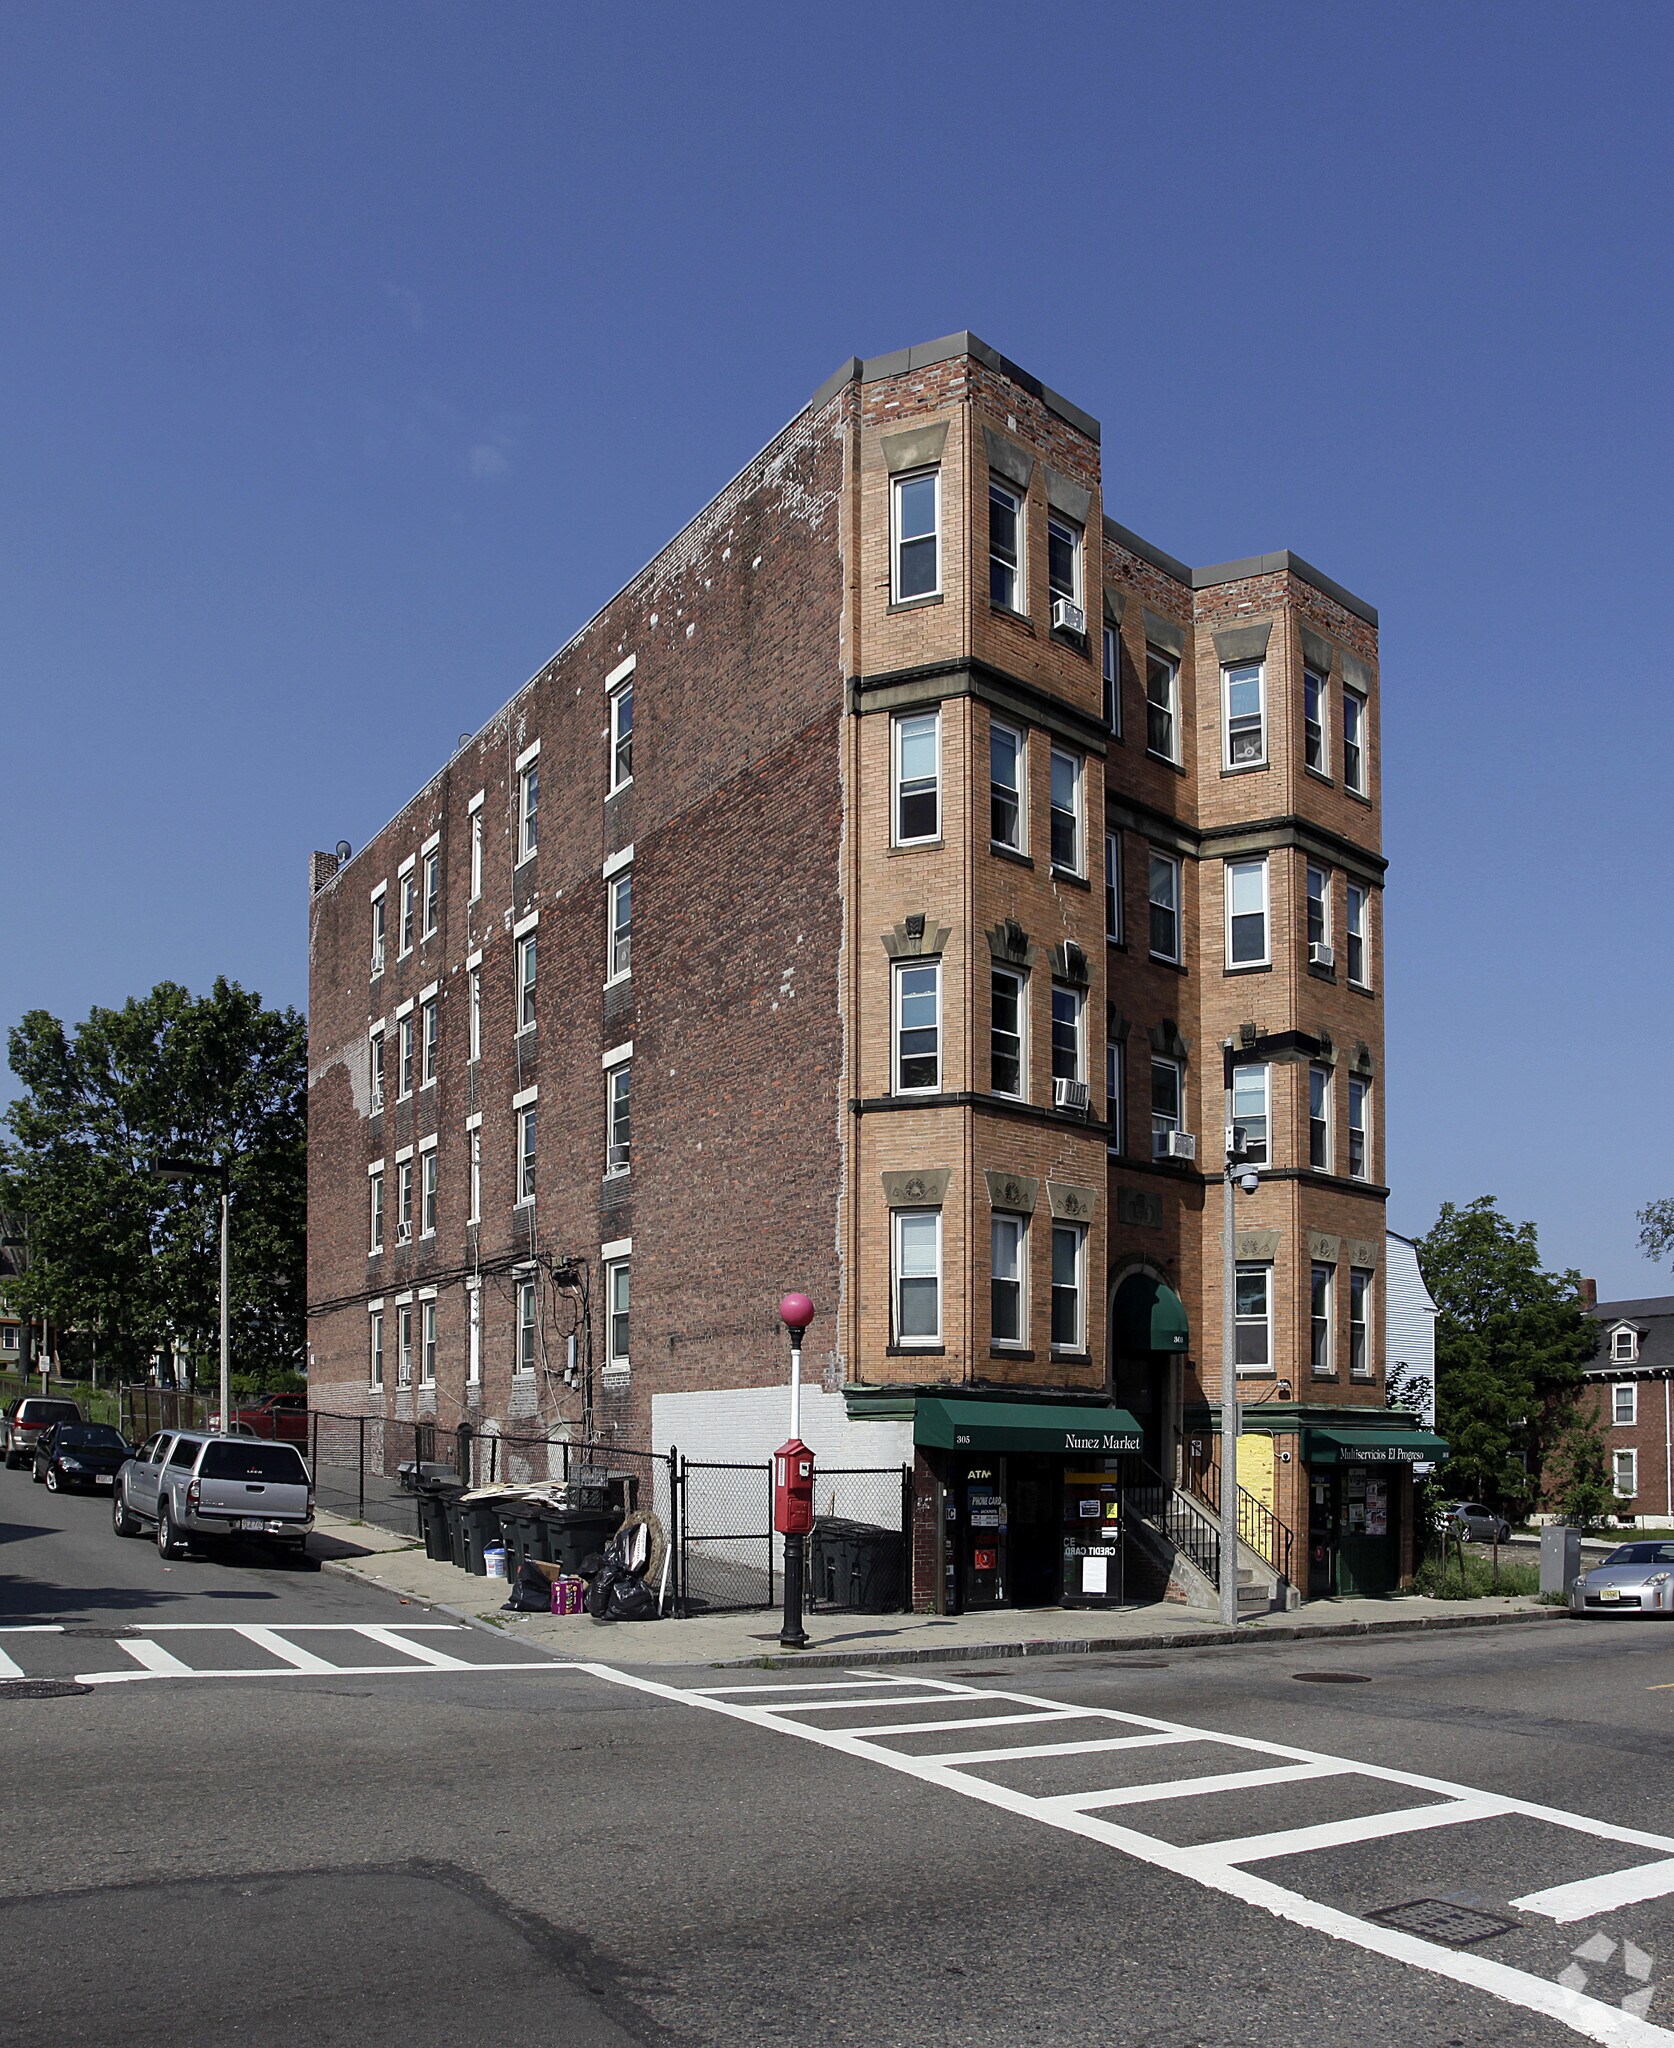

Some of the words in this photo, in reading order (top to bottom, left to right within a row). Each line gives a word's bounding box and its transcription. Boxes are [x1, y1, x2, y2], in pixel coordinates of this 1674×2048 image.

[956, 1435, 971, 1444] 305
[1064, 1433, 1100, 1449] Nunez
[1102, 1434, 1140, 1450] Market
[1340, 1447, 1386, 1460] Multiservicios
[1388, 1447, 1396, 1460] El
[1397, 1448, 1424, 1463] Progreso
[967, 1470, 992, 1479] ATM
[971, 1496, 988, 1506] PHONE
[988, 1496, 1002, 1506] CARD
